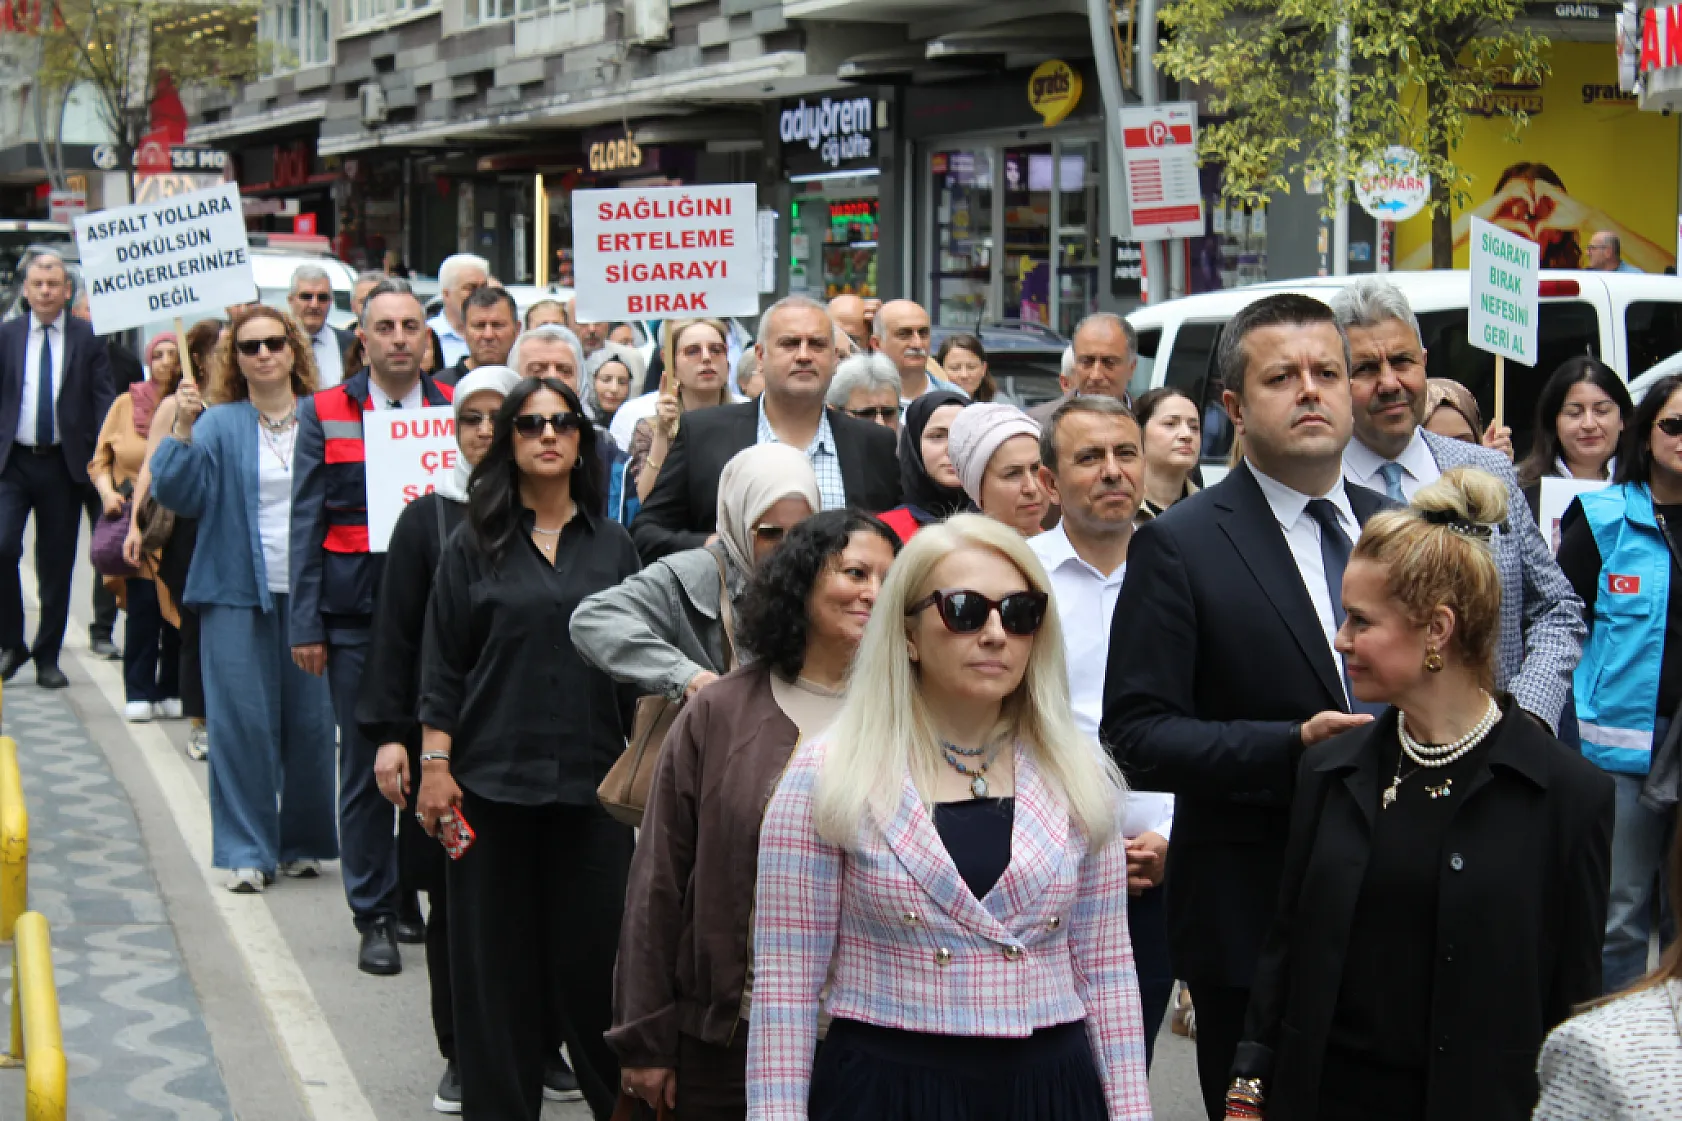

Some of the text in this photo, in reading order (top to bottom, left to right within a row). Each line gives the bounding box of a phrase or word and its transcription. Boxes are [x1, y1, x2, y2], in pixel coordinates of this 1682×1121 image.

[87, 195, 232, 242] ASFALT YOLLARA
[597, 194, 732, 221] SAĞLIĞINI
[115, 226, 212, 263] DÖKÜLSÜN
[597, 228, 734, 253] ERTELEME
[1481, 231, 1531, 270] SİGARAYI
[92, 247, 246, 296] AKCİĞERLERİNİZE
[605, 259, 727, 284] SİGARAYI
[1489, 264, 1522, 296] BIRAK
[148, 283, 200, 311] DEĞİL
[627, 291, 709, 313] BIRAK
[1480, 291, 1529, 328] NEFESİNİ
[1483, 323, 1526, 356] GERİ AL
